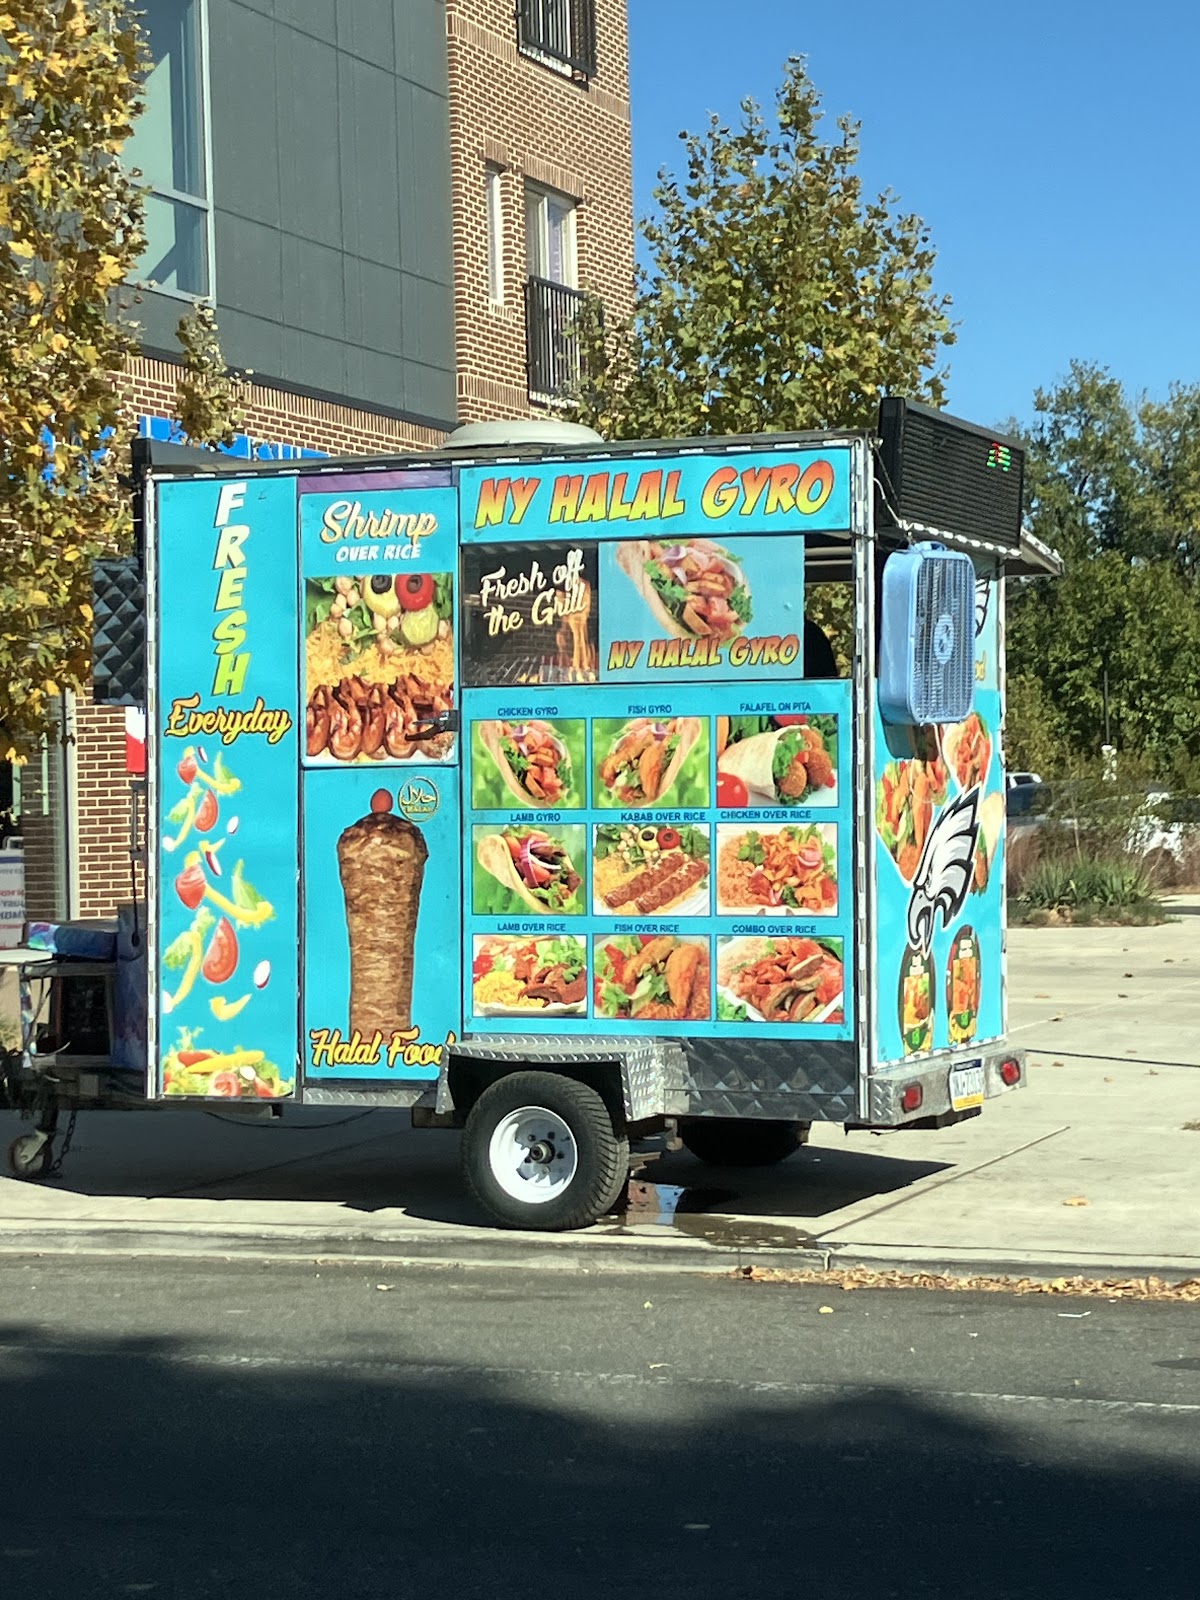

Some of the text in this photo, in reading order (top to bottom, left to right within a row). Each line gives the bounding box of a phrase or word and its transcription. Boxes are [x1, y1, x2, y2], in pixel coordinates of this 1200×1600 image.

[474, 460, 835, 529] NY HALAL GYRO
[320, 500, 438, 545] Shrimp
[336, 544, 421, 562] OVER RICE
[480, 549, 585, 607] Fresh off
[212, 482, 251, 696] FRESH
[483, 582, 586, 636] the Grill
[607, 633, 800, 671] NY HALAL GYRO
[497, 706, 558, 716] CHICKEN GYRO
[628, 704, 672, 714] FISH GYRO
[740, 702, 811, 712] FALAFEL ON PITA
[164, 692, 292, 745] Everyday
[510, 813, 561, 822] LAMB GYRO
[620, 811, 705, 821] KABAB OVER RICE
[720, 810, 812, 819] CHICKEN OVER RICE
[497, 923, 566, 932] LAMB OVER RICE
[614, 923, 680, 933] FISH OVER RICE
[732, 924, 817, 934] COMBO OVER RICE
[309, 1027, 383, 1067] Halal
